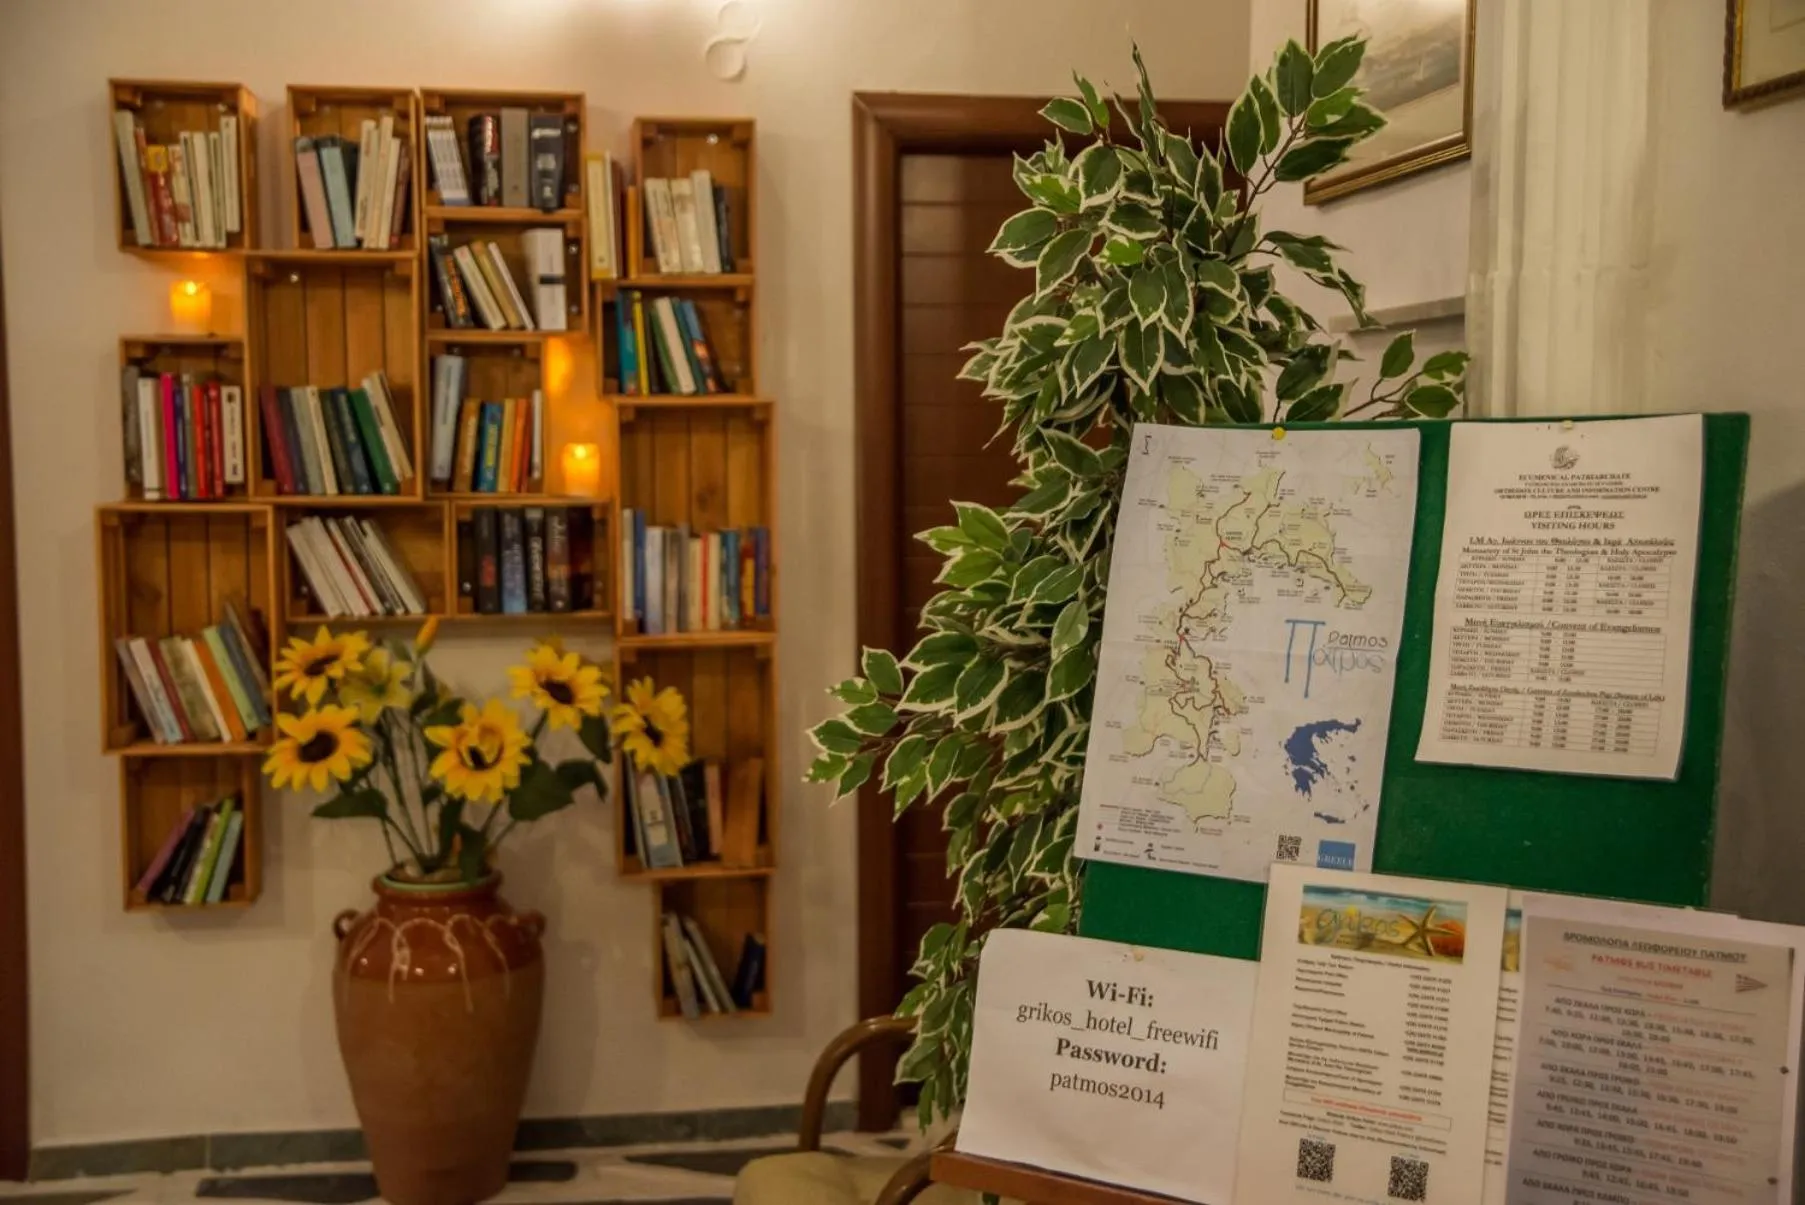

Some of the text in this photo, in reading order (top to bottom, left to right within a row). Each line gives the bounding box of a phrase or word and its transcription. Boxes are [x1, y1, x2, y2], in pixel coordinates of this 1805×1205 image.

[1578, 521, 1616, 530] HOURS
[1086, 979, 1154, 1008] Wi-Fi:
[1016, 1003, 1219, 1050] grikos_hotel_freewifi
[1055, 1037, 1167, 1074] Password:
[1050, 1071, 1165, 1110] patmos2014
